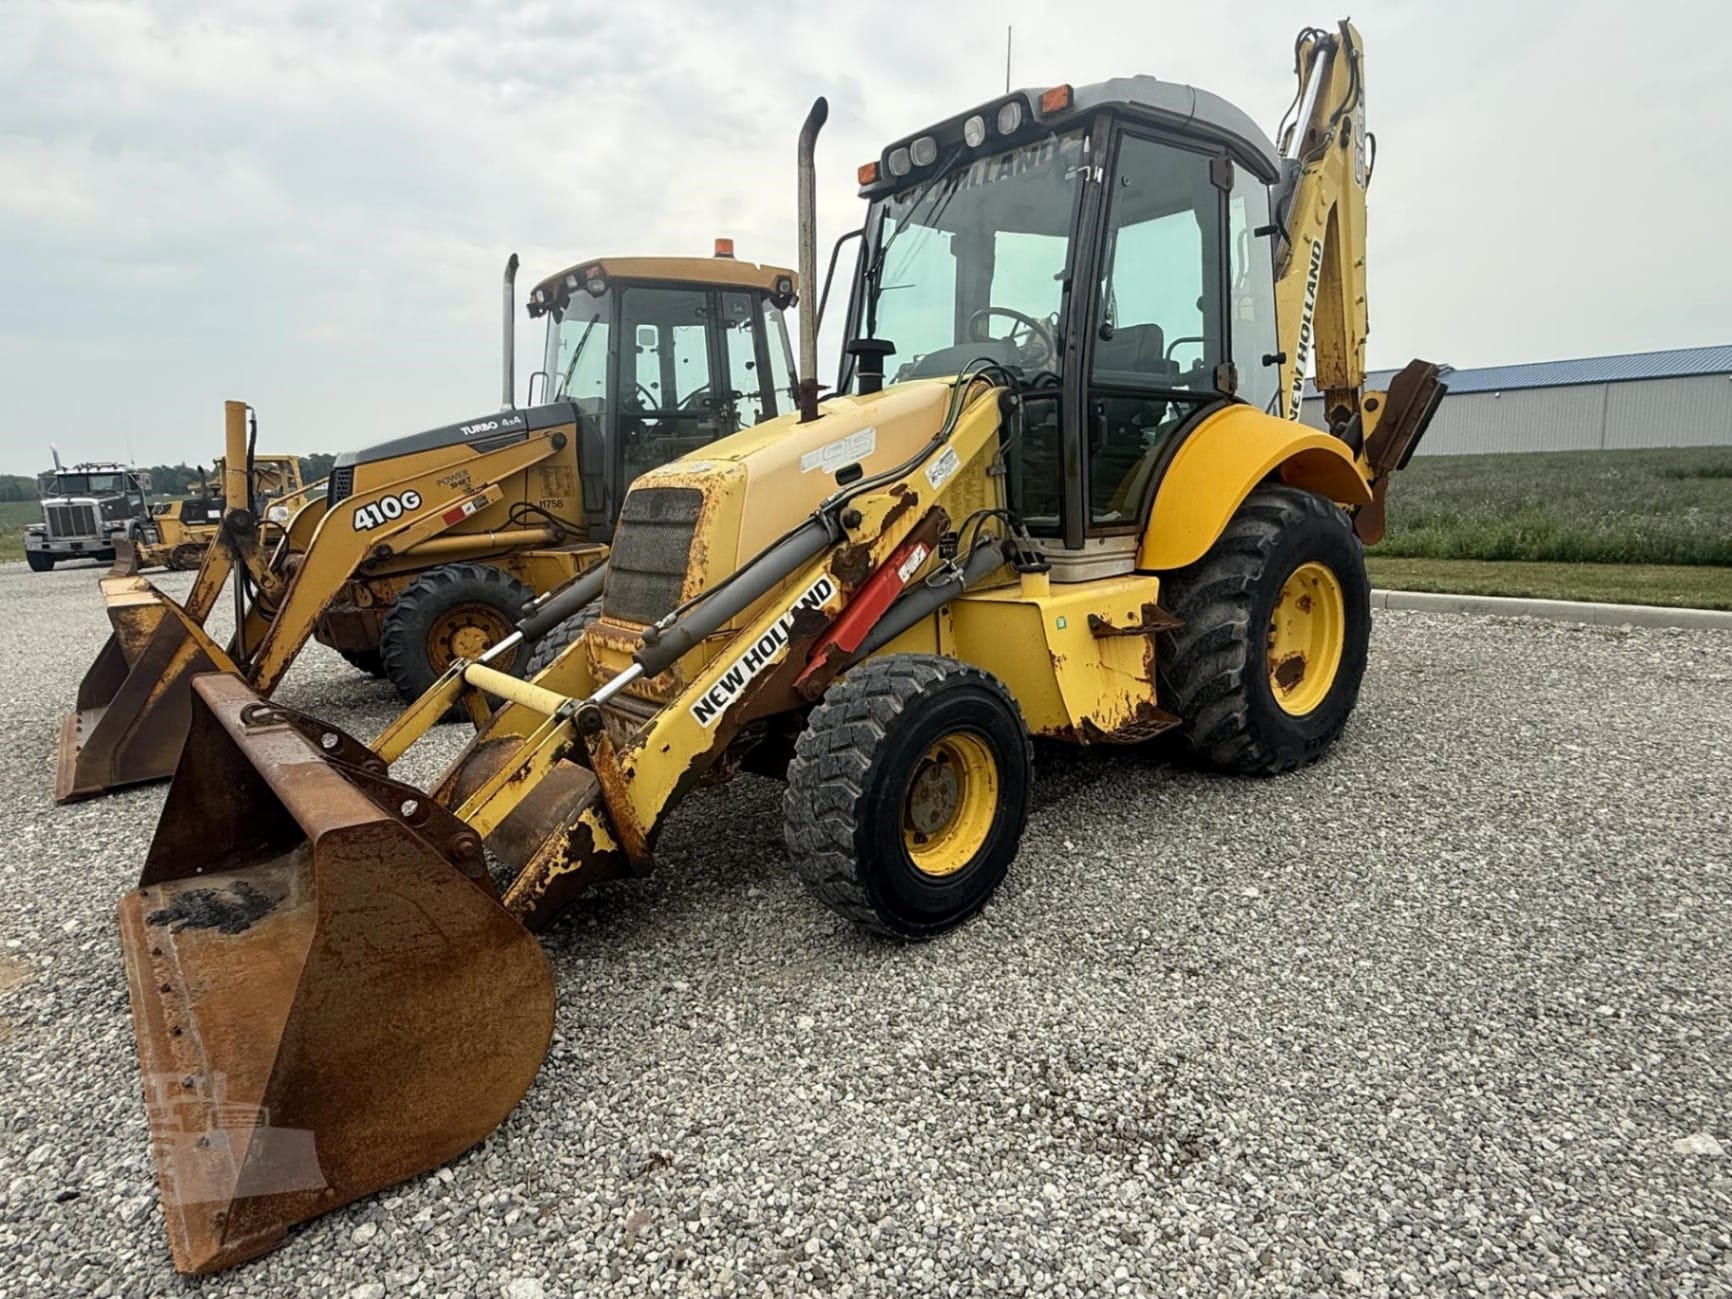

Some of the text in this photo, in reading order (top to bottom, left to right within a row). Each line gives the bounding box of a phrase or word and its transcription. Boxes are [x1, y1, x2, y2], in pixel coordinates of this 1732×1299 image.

[1288, 240, 1322, 422] NEW HOLLAND
[460, 416, 521, 435] TURBO 4x4
[353, 490, 422, 531] 410G
[692, 667, 745, 724] NEW
